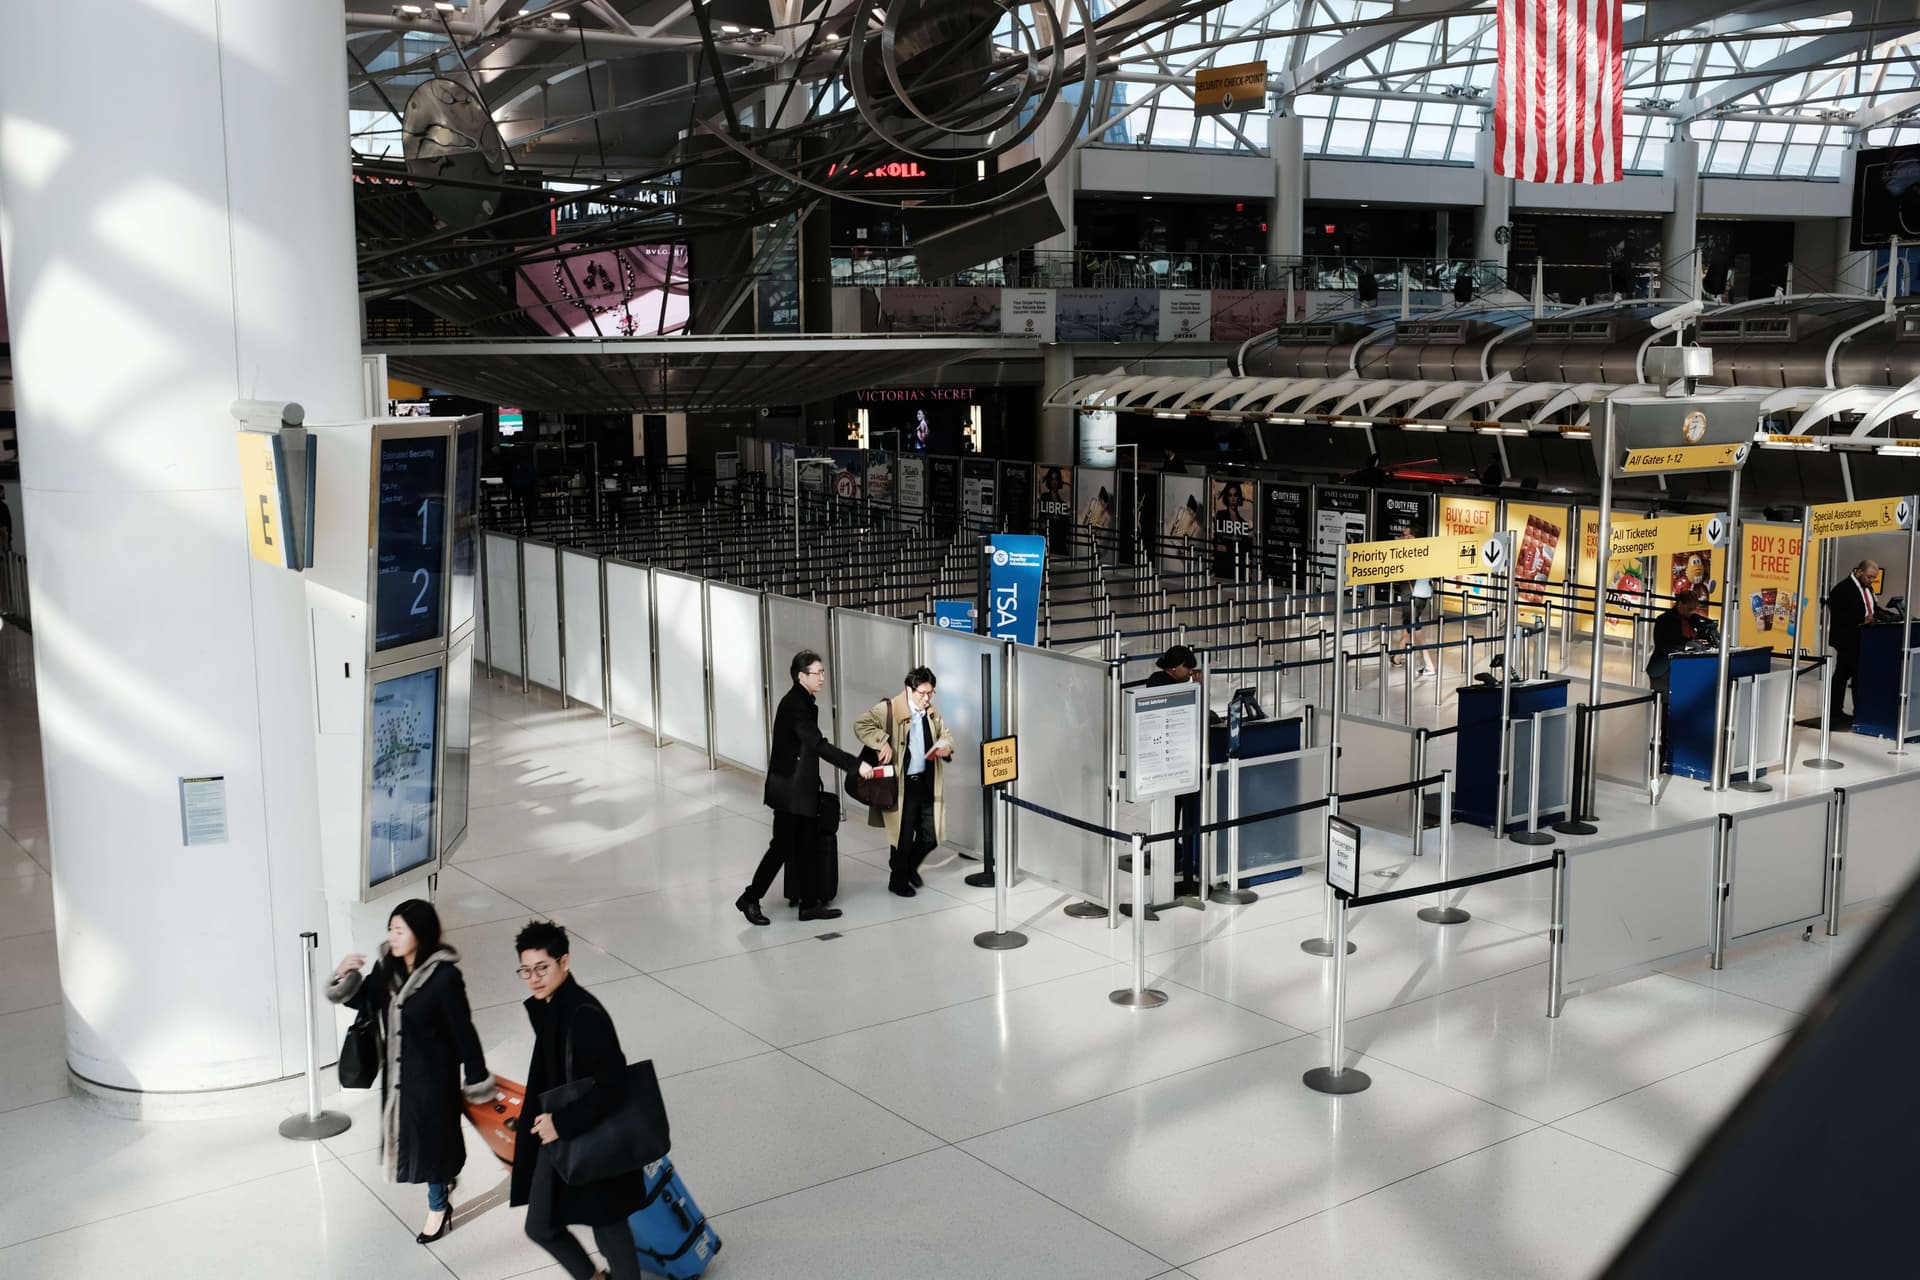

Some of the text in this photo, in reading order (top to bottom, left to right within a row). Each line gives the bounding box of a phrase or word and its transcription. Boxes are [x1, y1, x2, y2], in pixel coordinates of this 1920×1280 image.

[1196, 80, 1222, 91] SECURITY
[856, 388, 976, 401] VICTORIA'S SECRET
[1629, 453, 1684, 466] All Gates 1-12
[1040, 500, 1068, 515] LIBRE
[1394, 500, 1407, 511] DUTY
[1407, 501, 1419, 512] FREE
[417, 498, 429, 545] 1
[1446, 507, 1490, 526] BUY 3 GET
[1814, 508, 1862, 522] Special Assistance
[1216, 519, 1249, 536] LIBRE
[1446, 523, 1475, 536] 1 FREE
[1587, 522, 1600, 534] NO
[1613, 526, 1658, 541] All Ticketed
[1813, 518, 1879, 535] Flight Crew & Employees
[1612, 541, 1655, 555] Passengers
[1751, 535, 1775, 554] BUY
[1778, 537, 1785, 554] 3
[1352, 545, 1429, 564] Priority Ticketed
[1351, 563, 1405, 578] Passengers
[1751, 554, 1791, 574] 1 FREE
[409, 567, 430, 616] 2
[996, 582, 1018, 628] TSA
[990, 745, 1009, 756] First &
[987, 756, 1013, 768] Business
[993, 768, 1009, 778] Class
